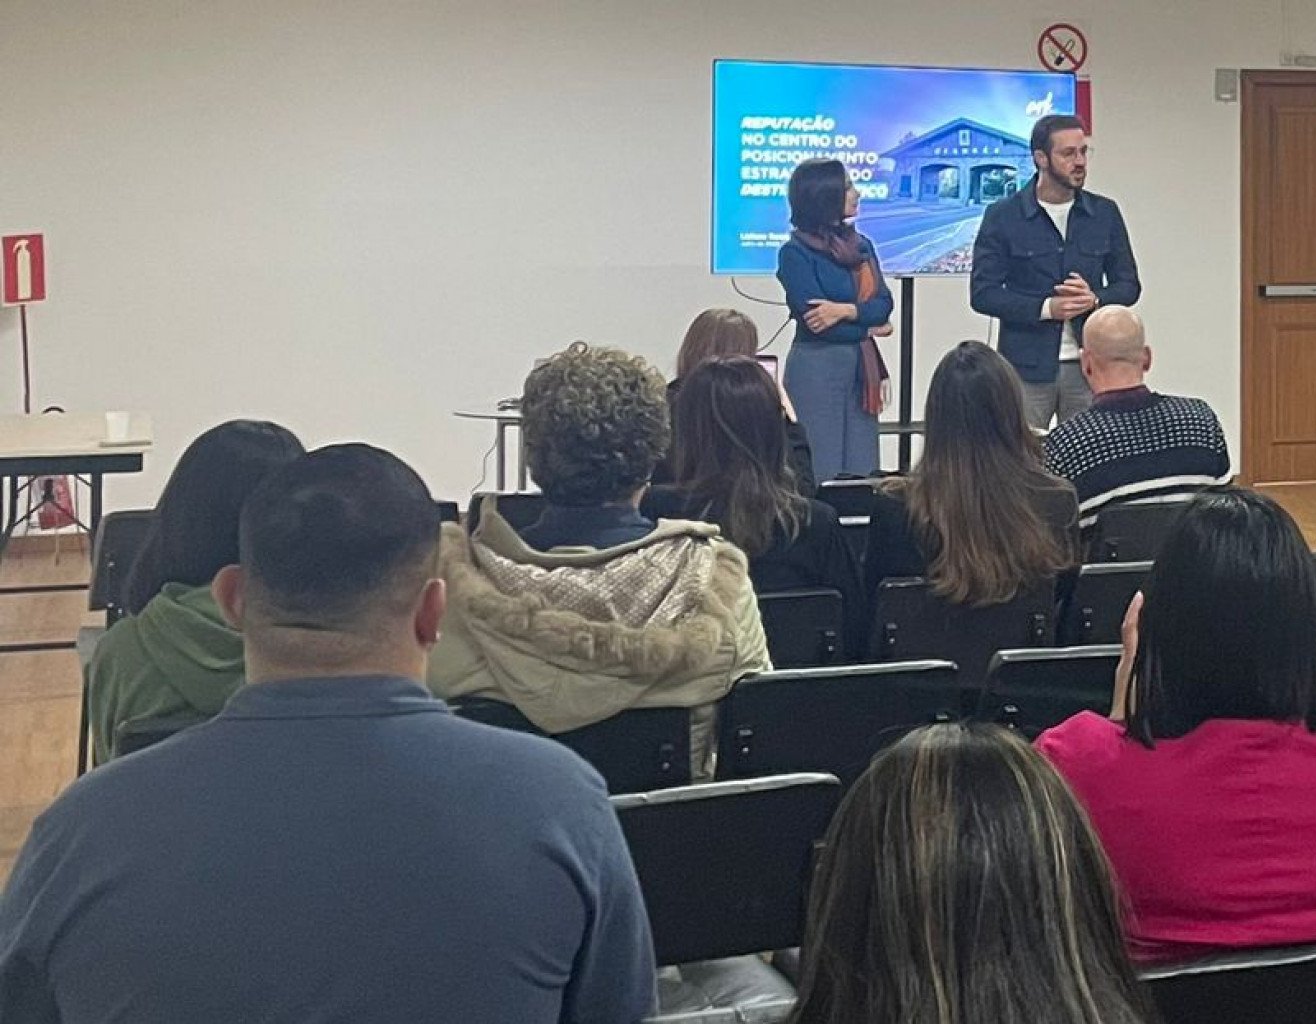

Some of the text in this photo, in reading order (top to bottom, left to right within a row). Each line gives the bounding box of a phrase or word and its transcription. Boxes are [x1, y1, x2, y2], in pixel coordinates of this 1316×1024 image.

[741, 115, 835, 131] REPUTAÇÃO
[742, 133, 857, 147] NO CENTRO DO
[742, 166, 872, 181] ESTRA DO
